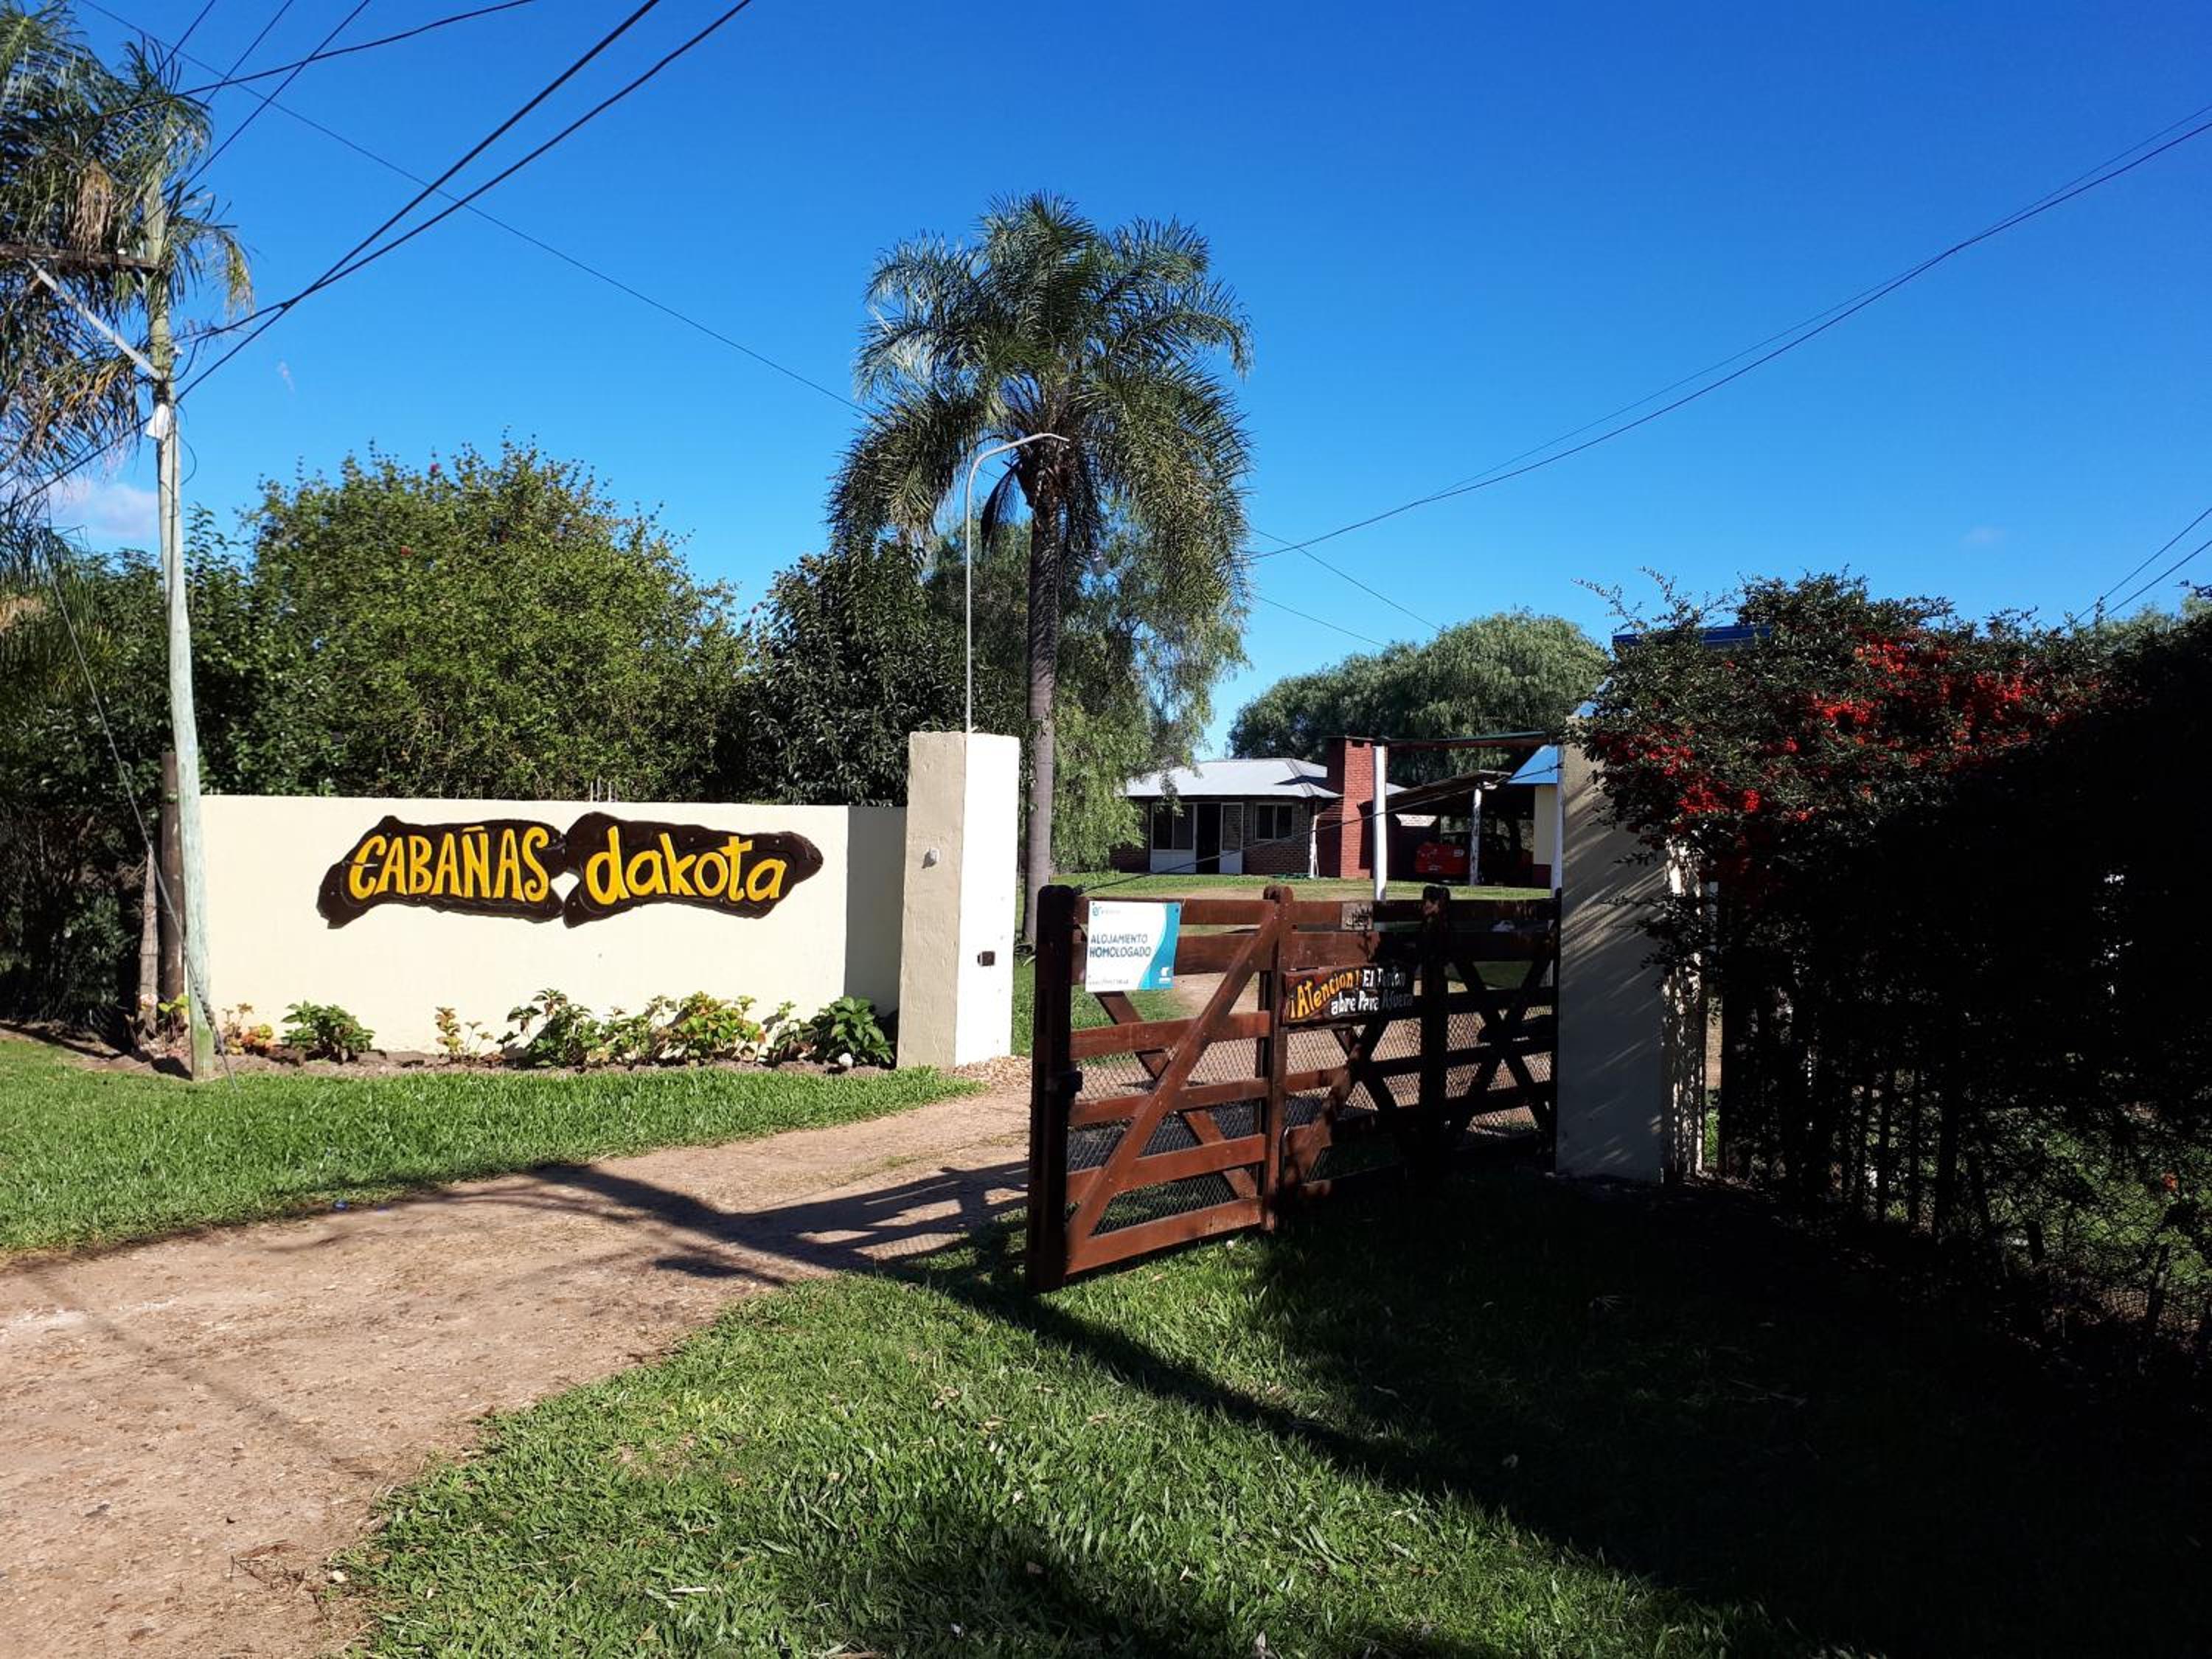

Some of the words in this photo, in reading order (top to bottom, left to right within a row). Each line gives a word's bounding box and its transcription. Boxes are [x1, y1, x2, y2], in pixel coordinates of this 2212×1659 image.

[347, 825, 549, 902] CABAÑAS
[585, 826, 787, 905] dakota
[1091, 933, 1148, 944] ALOJAMIENTO
[1089, 946, 1151, 958] HOMOLOGADO
[1362, 968, 1375, 987] El
[1331, 991, 1356, 1015] abre
